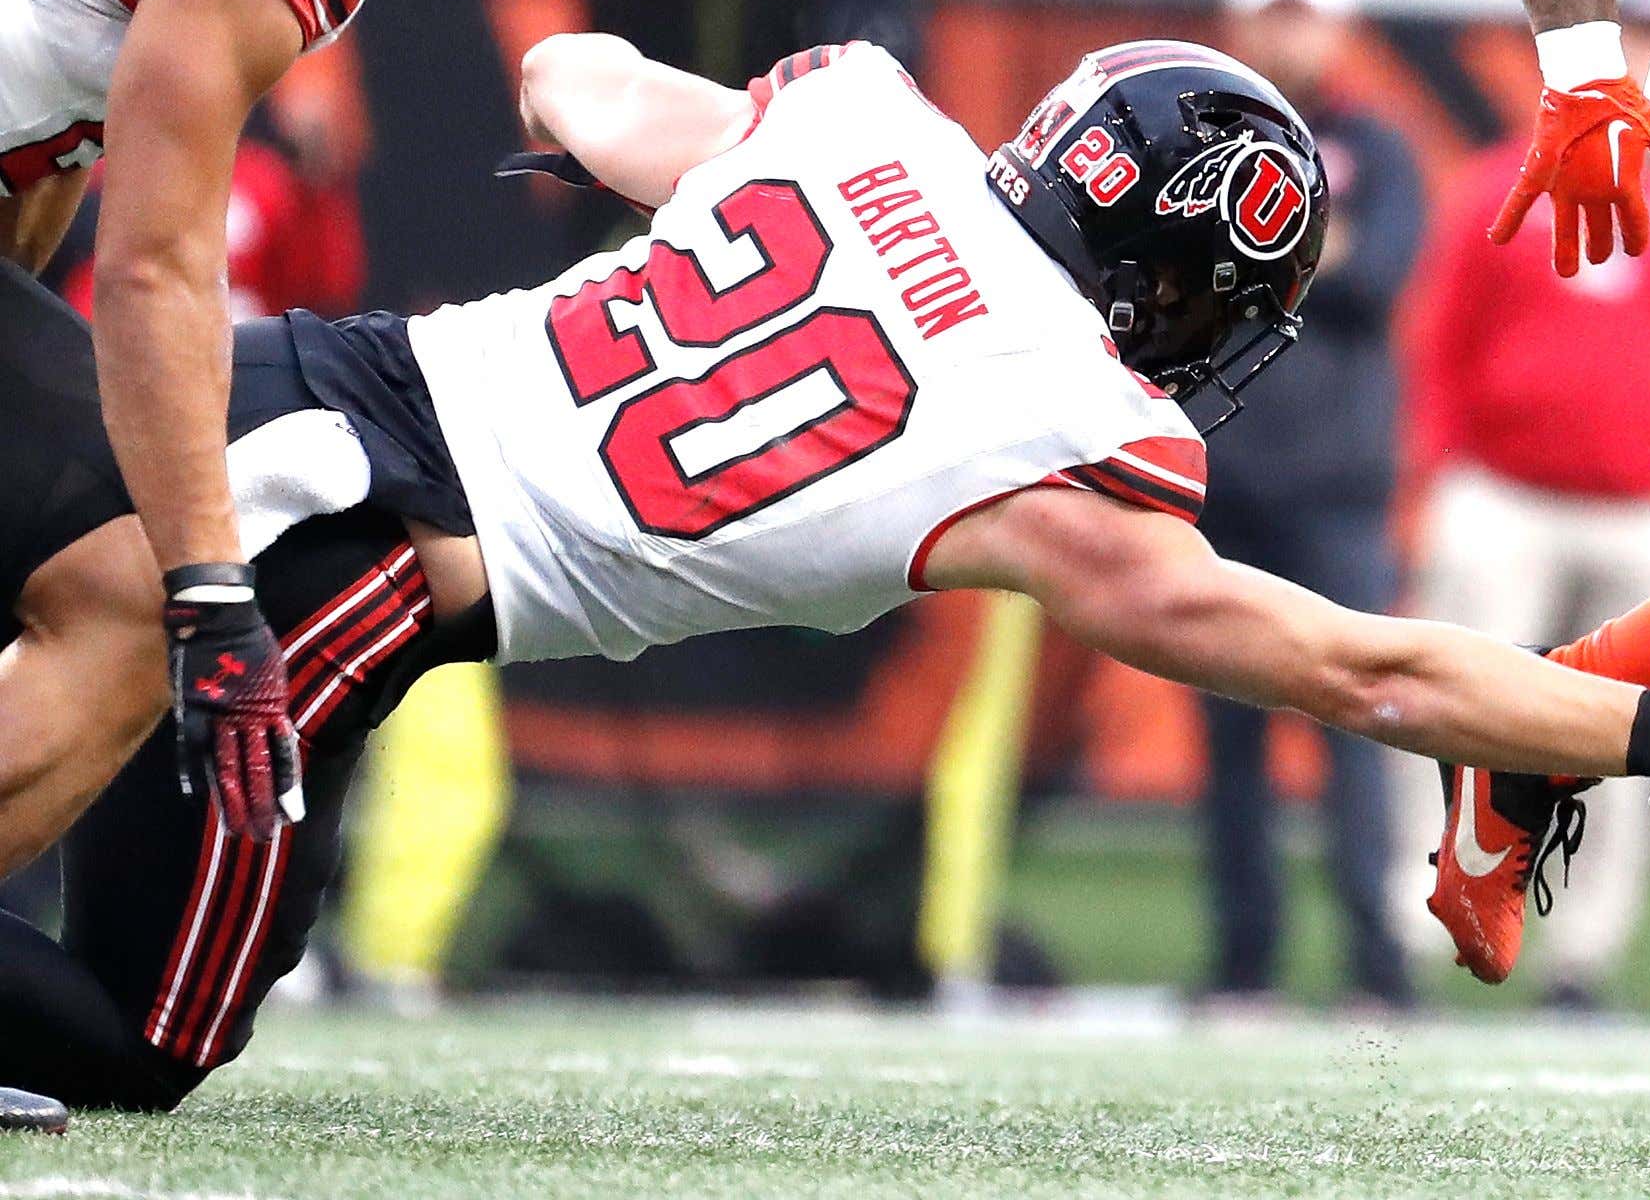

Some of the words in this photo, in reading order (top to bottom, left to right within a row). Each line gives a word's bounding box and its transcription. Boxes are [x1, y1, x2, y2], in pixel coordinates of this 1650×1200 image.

[1058, 125, 1141, 207] 20
[1235, 151, 1306, 247] U
[837, 160, 989, 341] BARTON
[544, 178, 919, 542] 20
